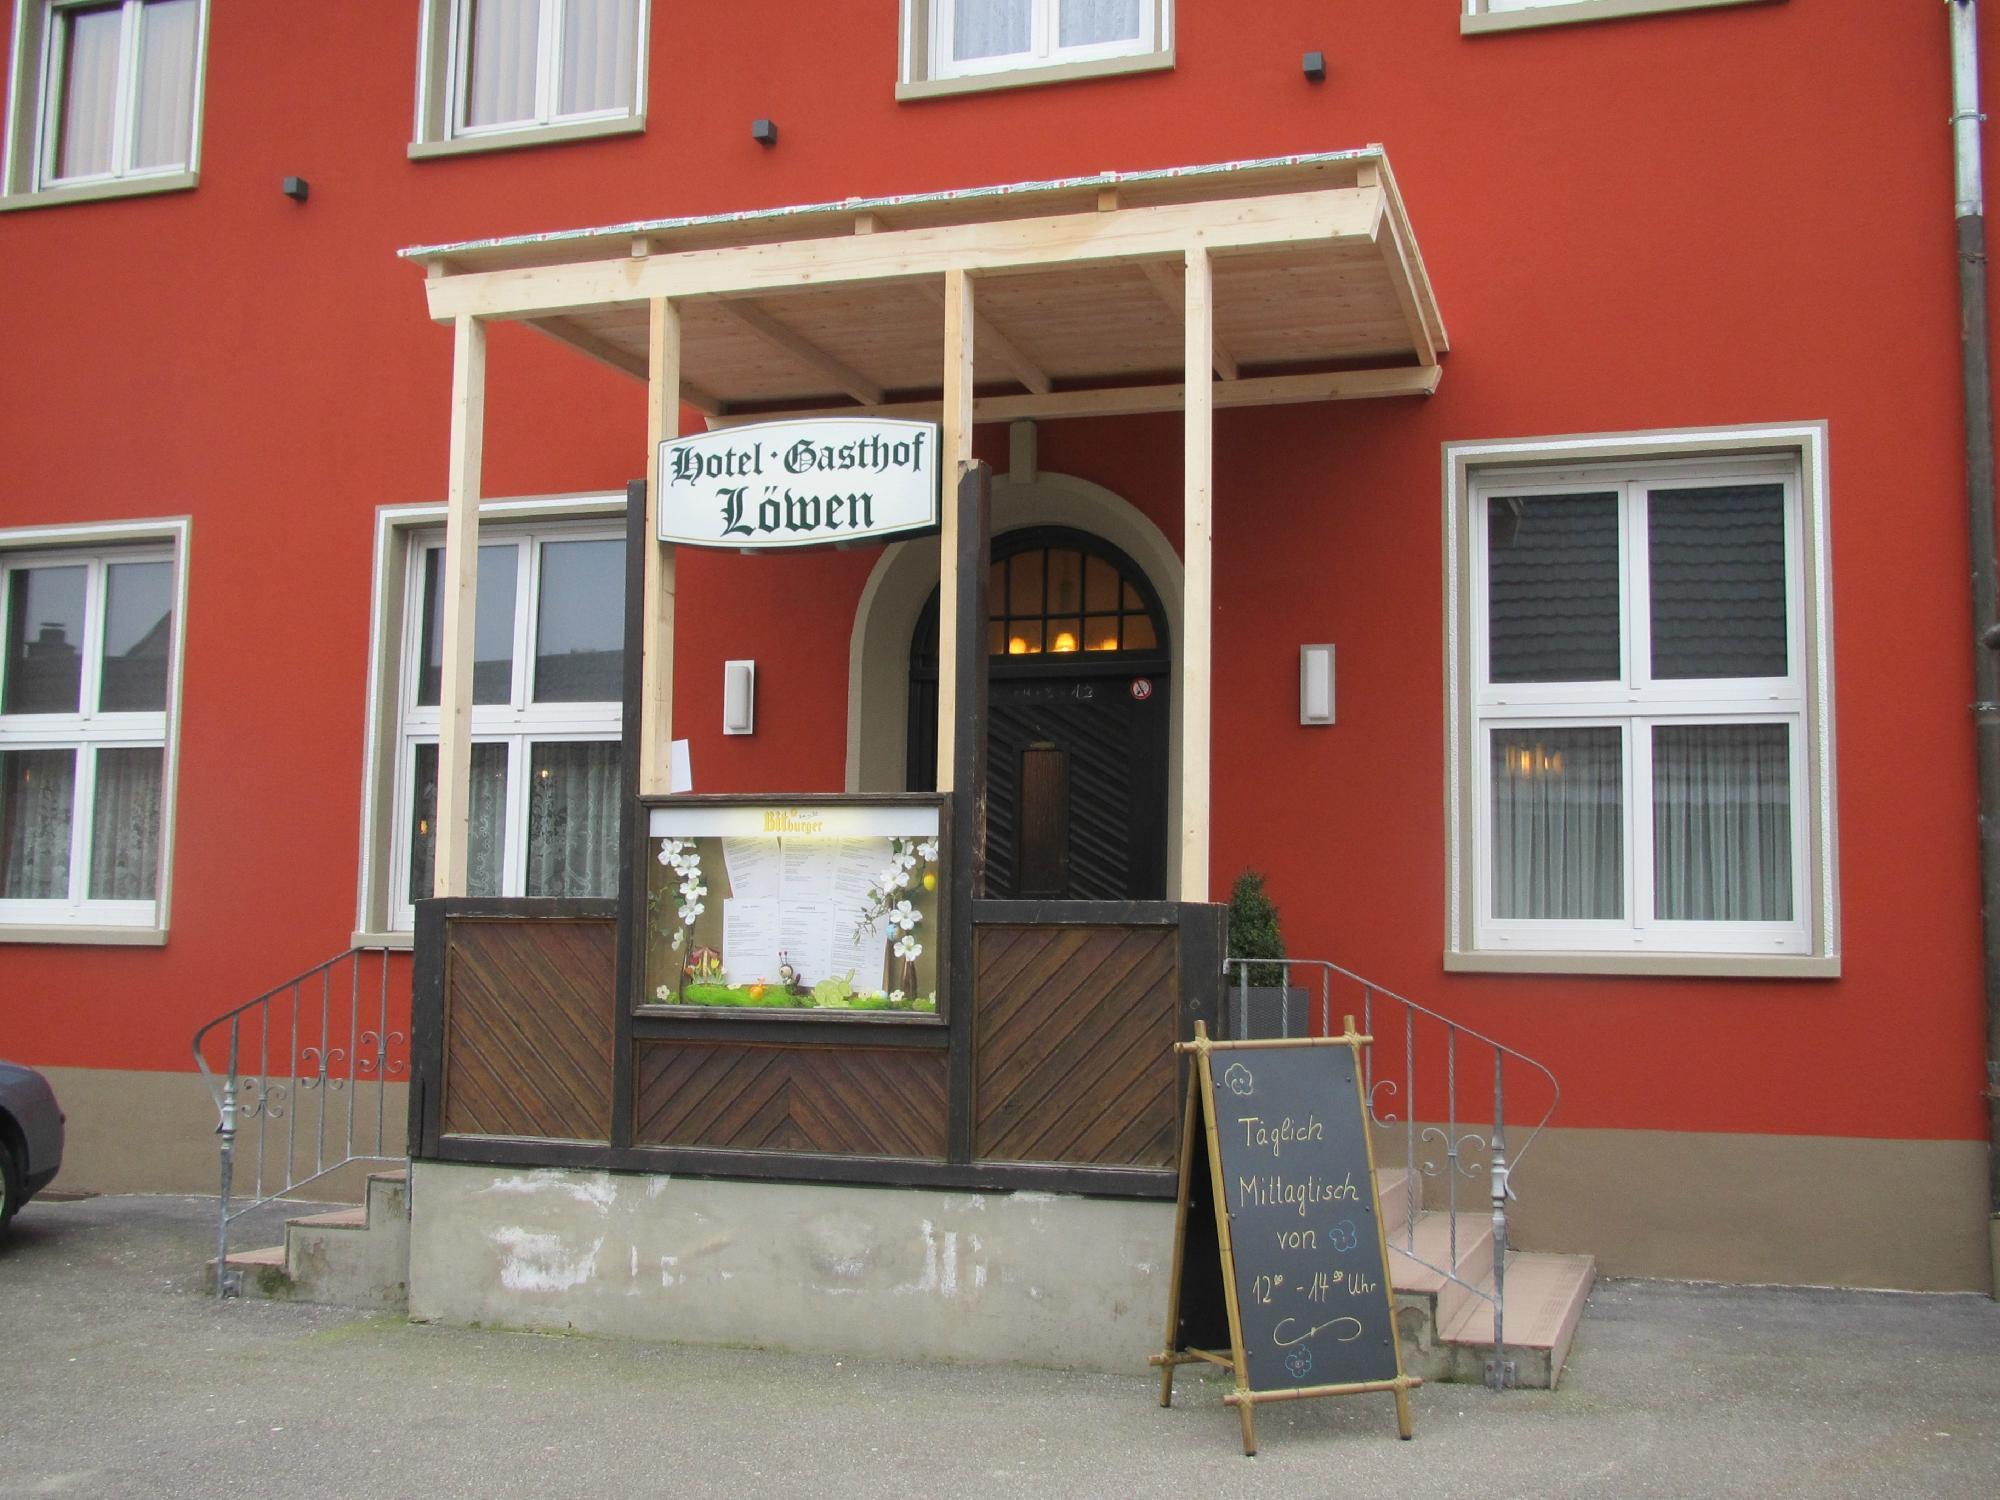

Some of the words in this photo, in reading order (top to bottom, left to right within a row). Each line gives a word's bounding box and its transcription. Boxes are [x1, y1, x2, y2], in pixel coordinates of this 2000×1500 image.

[670, 442, 763, 486] Hotel
[784, 431, 926, 474] Gasthof
[715, 485, 874, 537] Löwen
[763, 809, 823, 833] Bitburger
[1238, 1115, 1324, 1157] Täglich
[1239, 1172, 1360, 1216] Mittagtisch
[1277, 1229, 1317, 1250] von
[1348, 1273, 1376, 1295] Uhr
